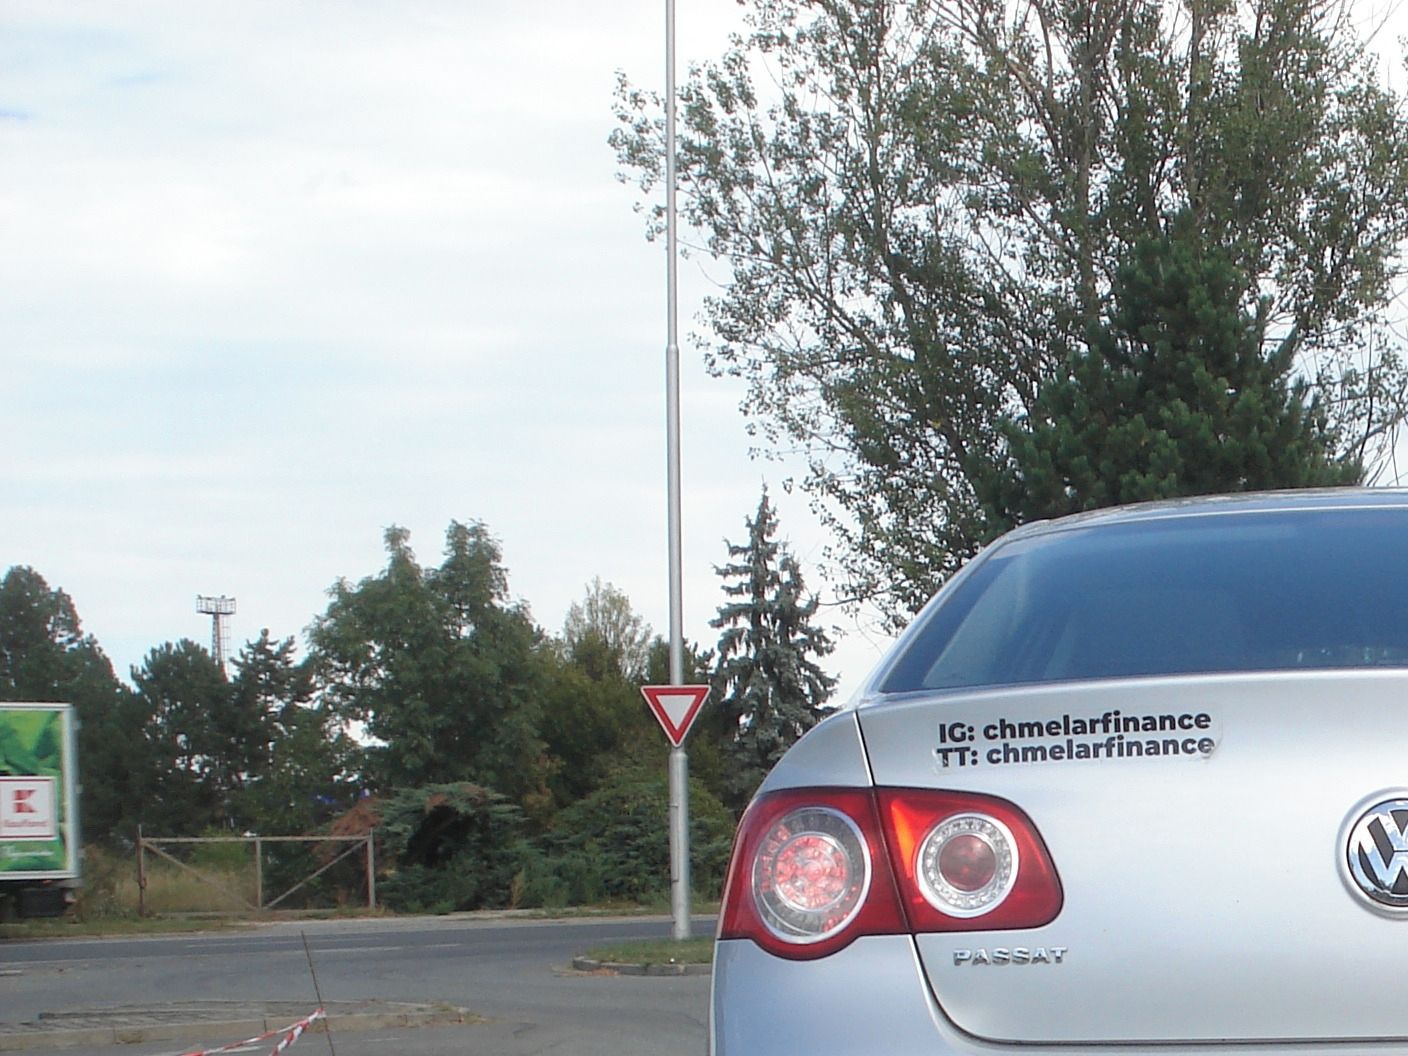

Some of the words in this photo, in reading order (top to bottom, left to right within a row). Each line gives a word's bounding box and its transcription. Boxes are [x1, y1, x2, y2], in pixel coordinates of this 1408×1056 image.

[938, 722, 975, 744] IG:
[983, 710, 1212, 741] chmelarfinance
[936, 746, 978, 768] TT:
[986, 735, 1215, 765] chmelarfinance
[953, 946, 1068, 966] PASSAT
